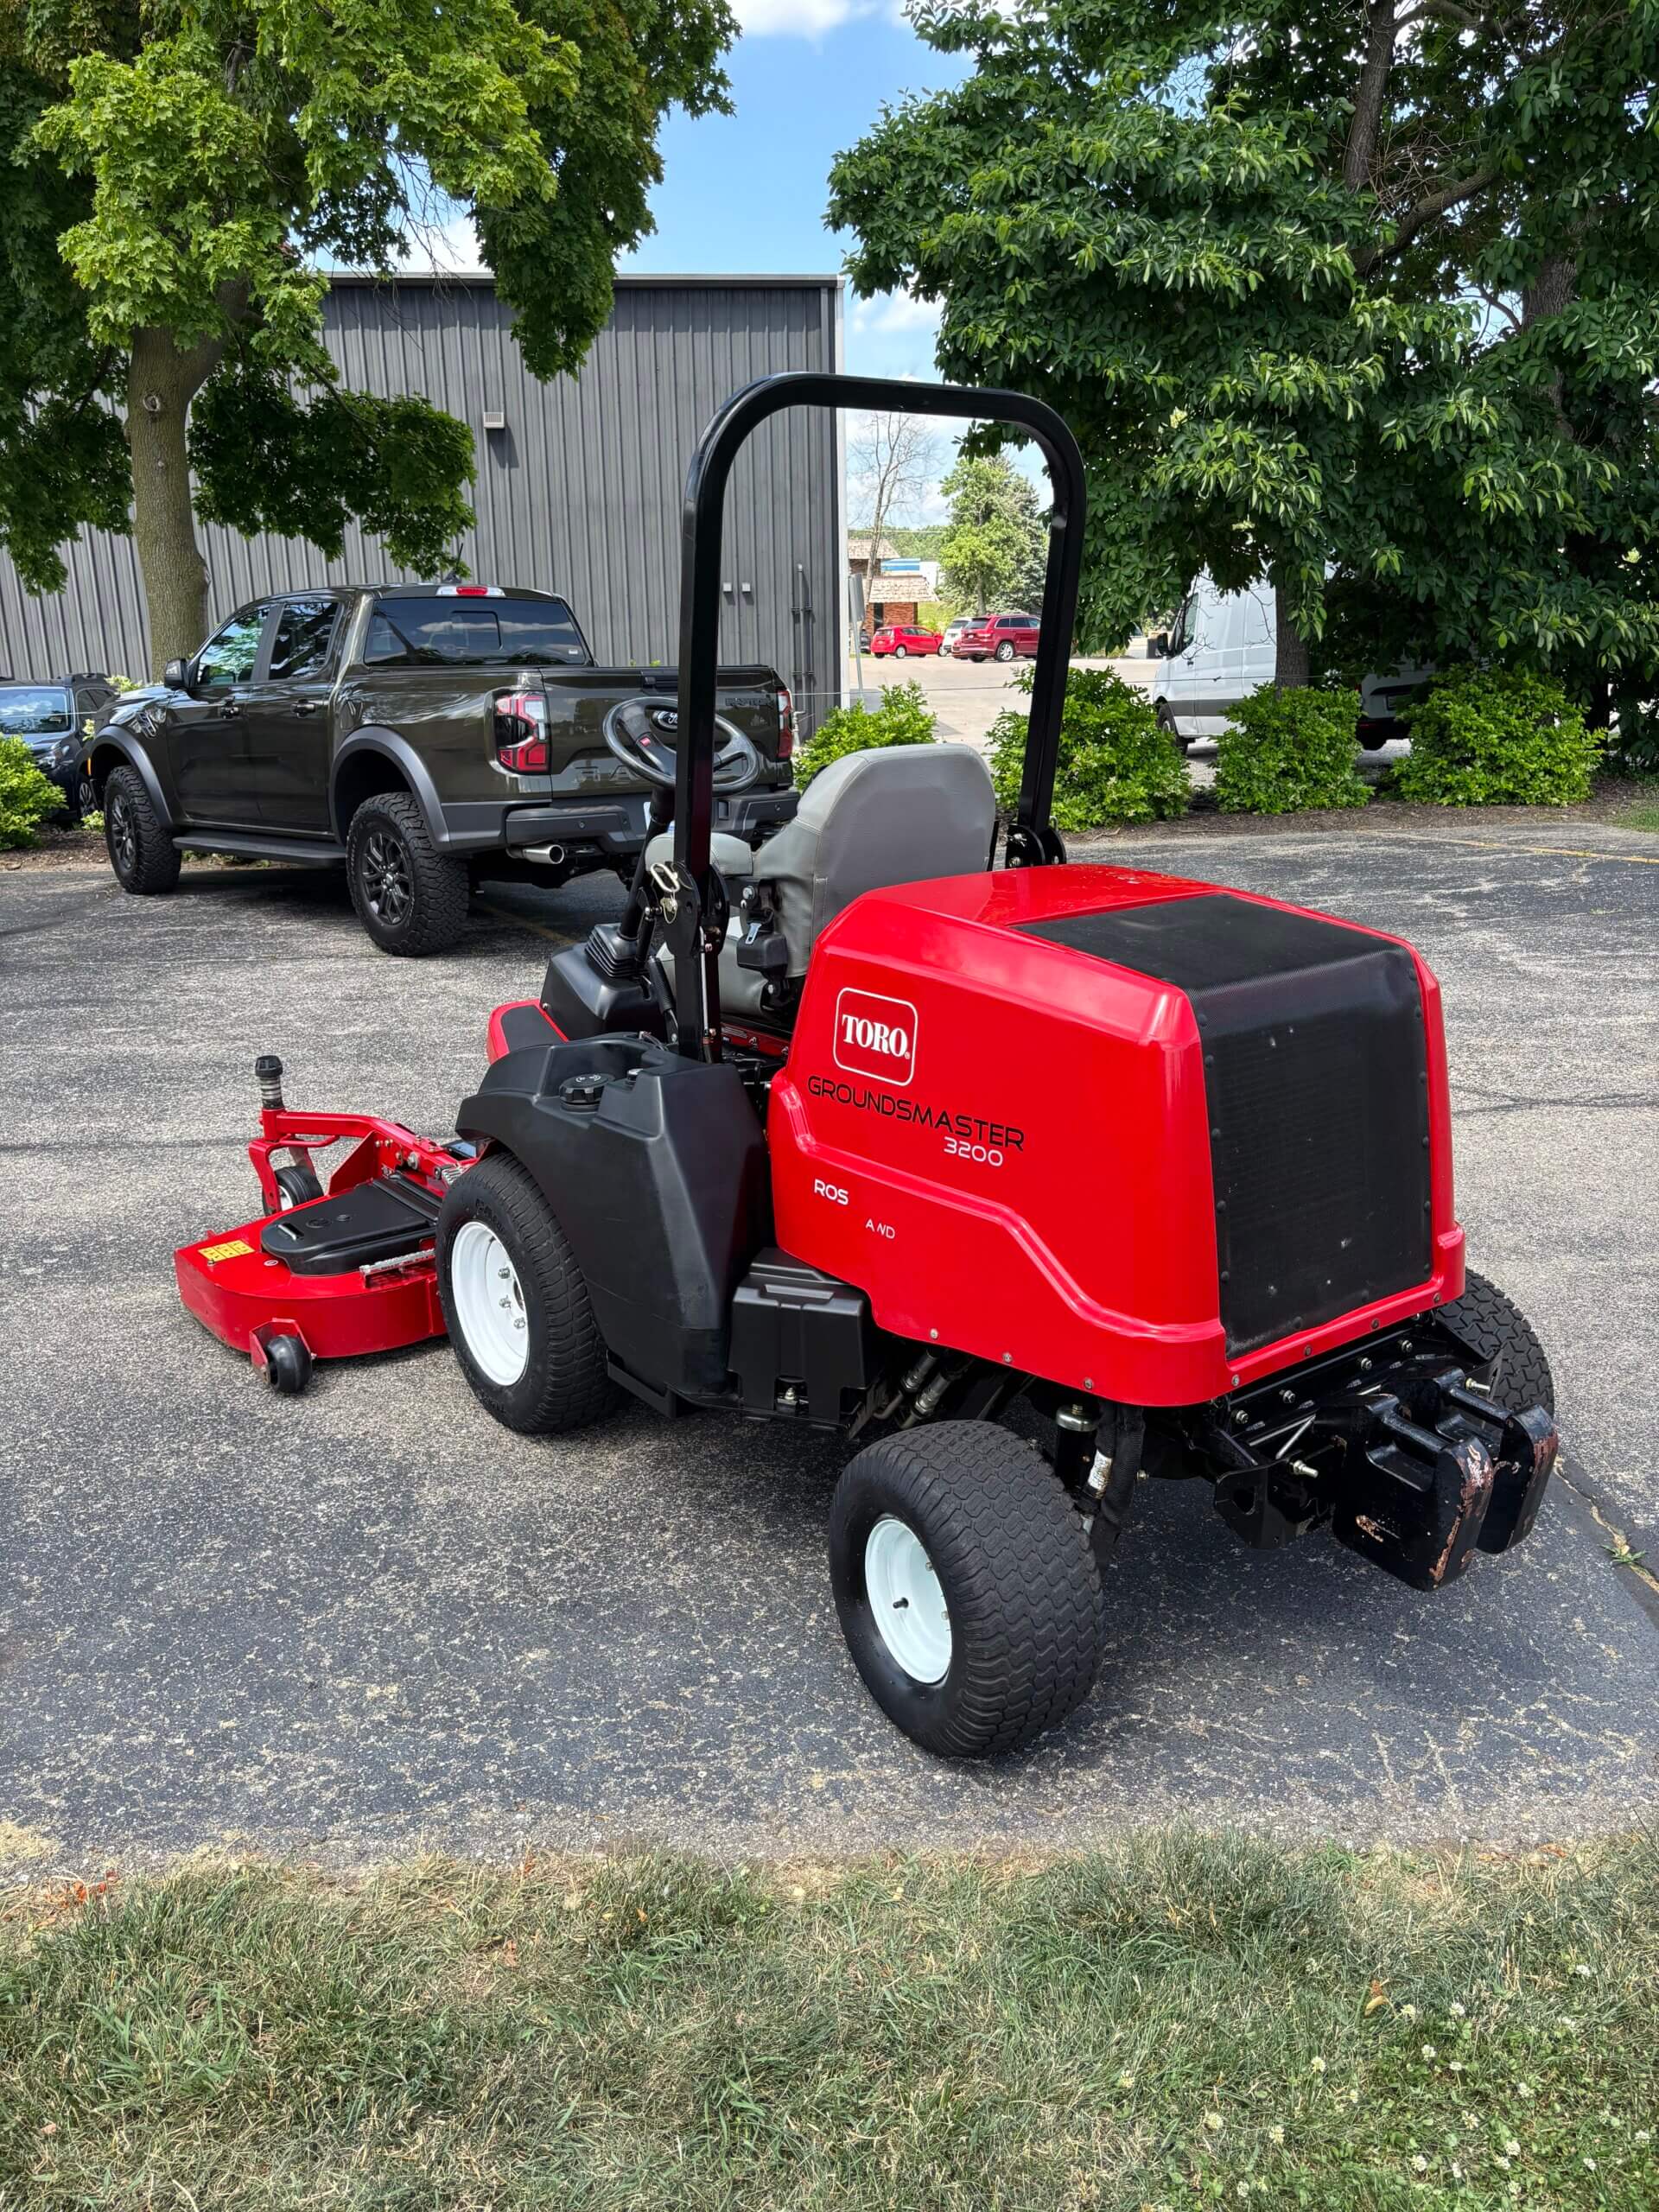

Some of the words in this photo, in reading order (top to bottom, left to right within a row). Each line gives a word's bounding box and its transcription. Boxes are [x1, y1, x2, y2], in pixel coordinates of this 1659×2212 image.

[842, 1014, 908, 1058] TORO
[807, 1075, 1025, 1151] GROUNDSMASTER
[944, 1136, 1003, 1166] 3200
[813, 1178, 849, 1205] ROS
